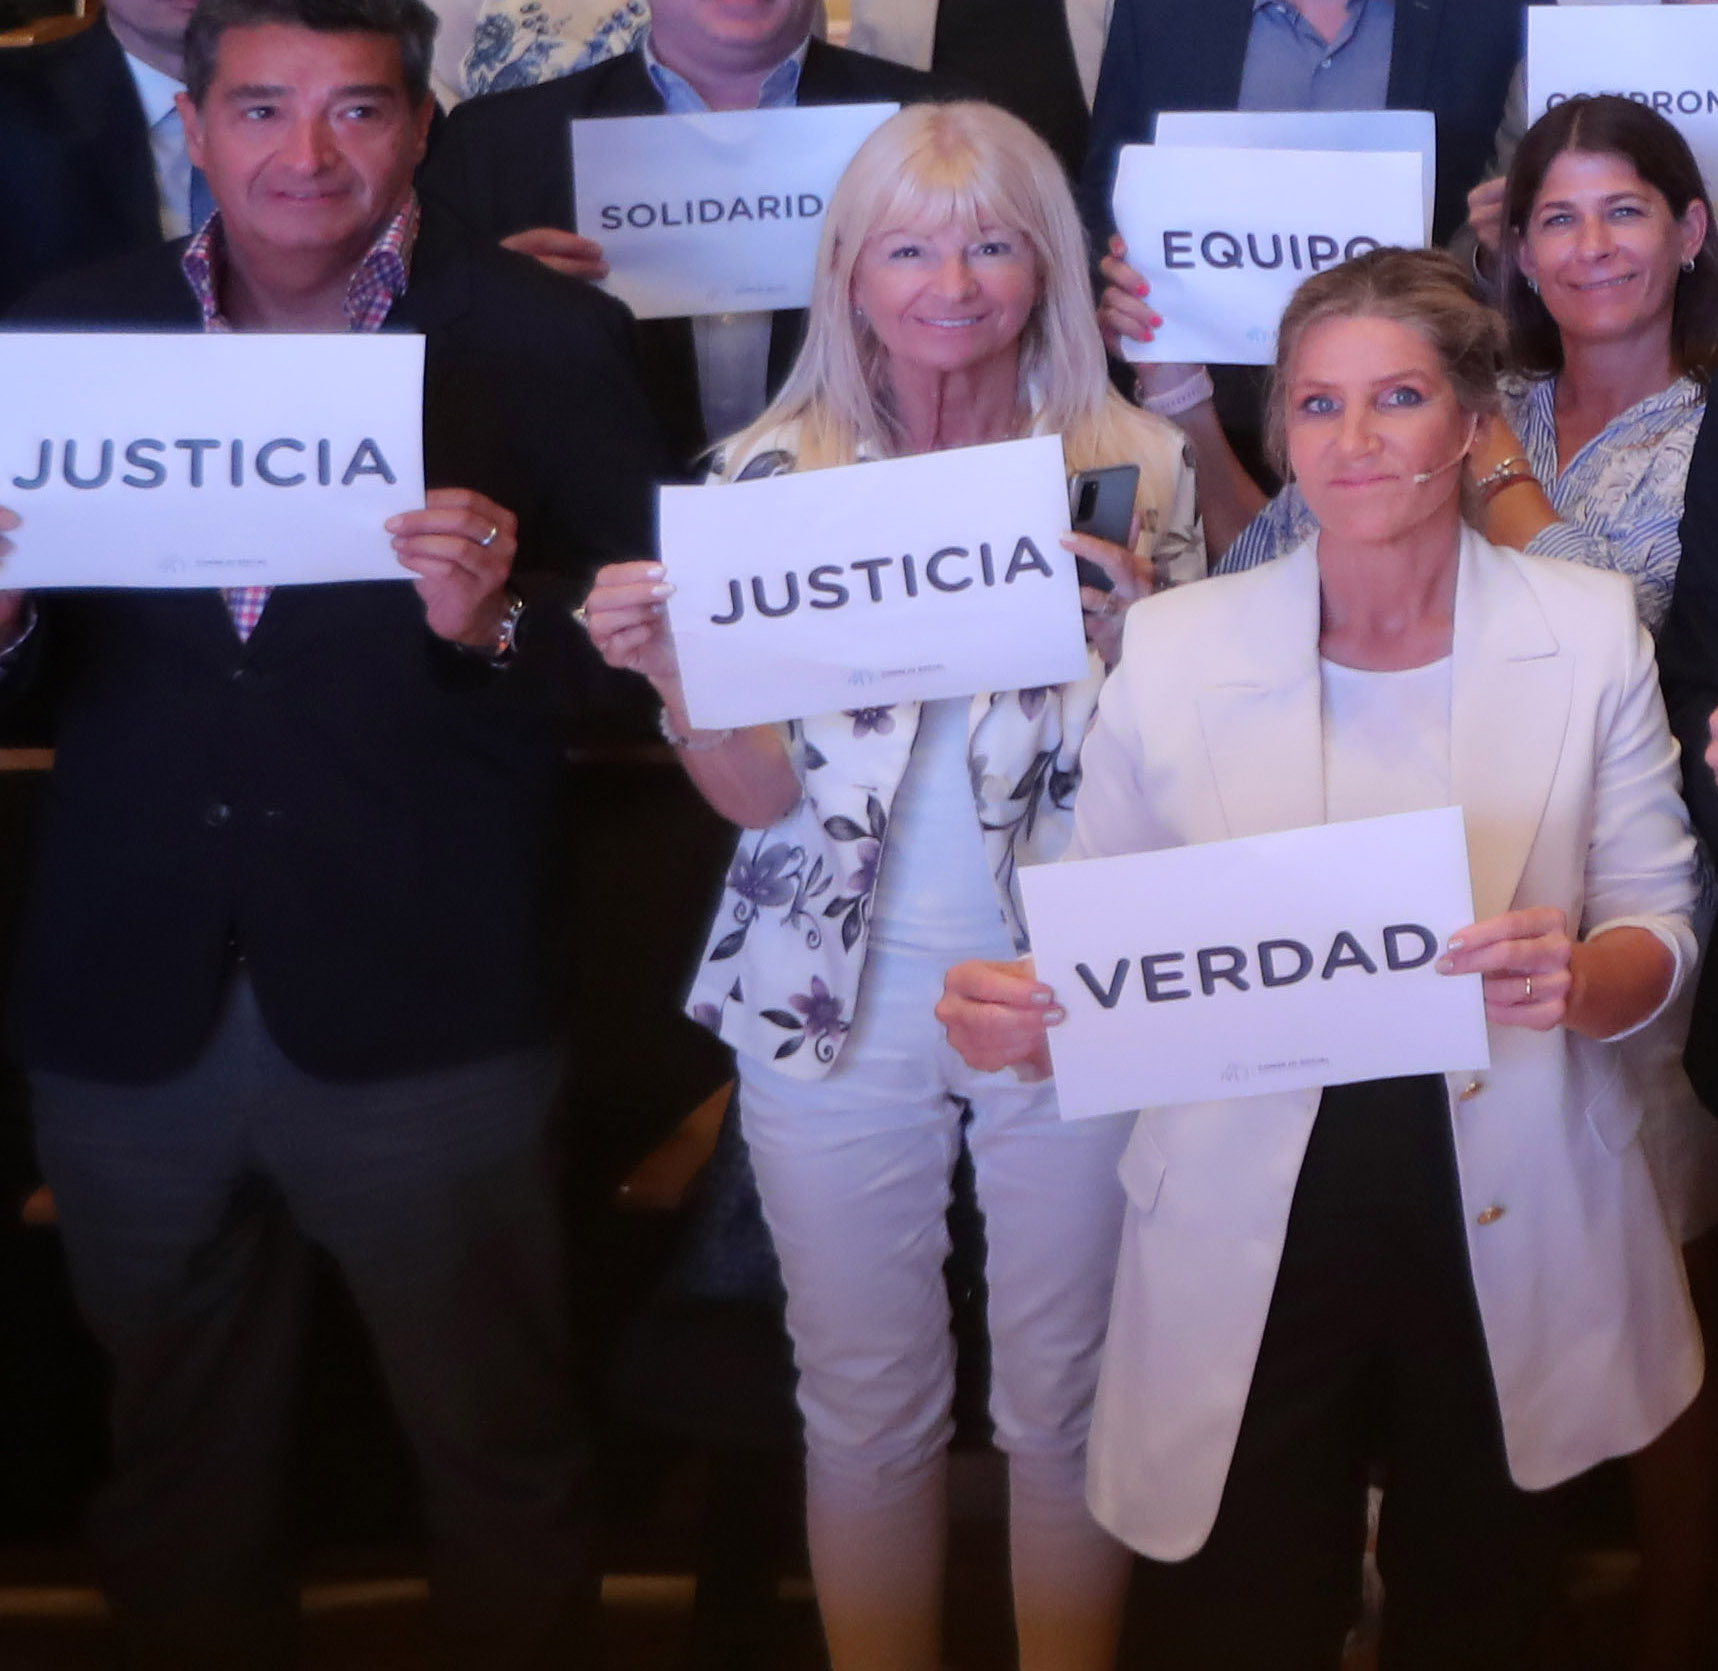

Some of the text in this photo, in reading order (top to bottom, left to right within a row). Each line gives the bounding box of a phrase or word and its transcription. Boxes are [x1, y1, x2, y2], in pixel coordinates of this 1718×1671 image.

[600, 193, 823, 229] SOLIDARID
[11, 436, 398, 492] JUSTICIA
[710, 534, 1054, 626] JUSTICIA
[1075, 920, 1443, 1011] VERDAD
